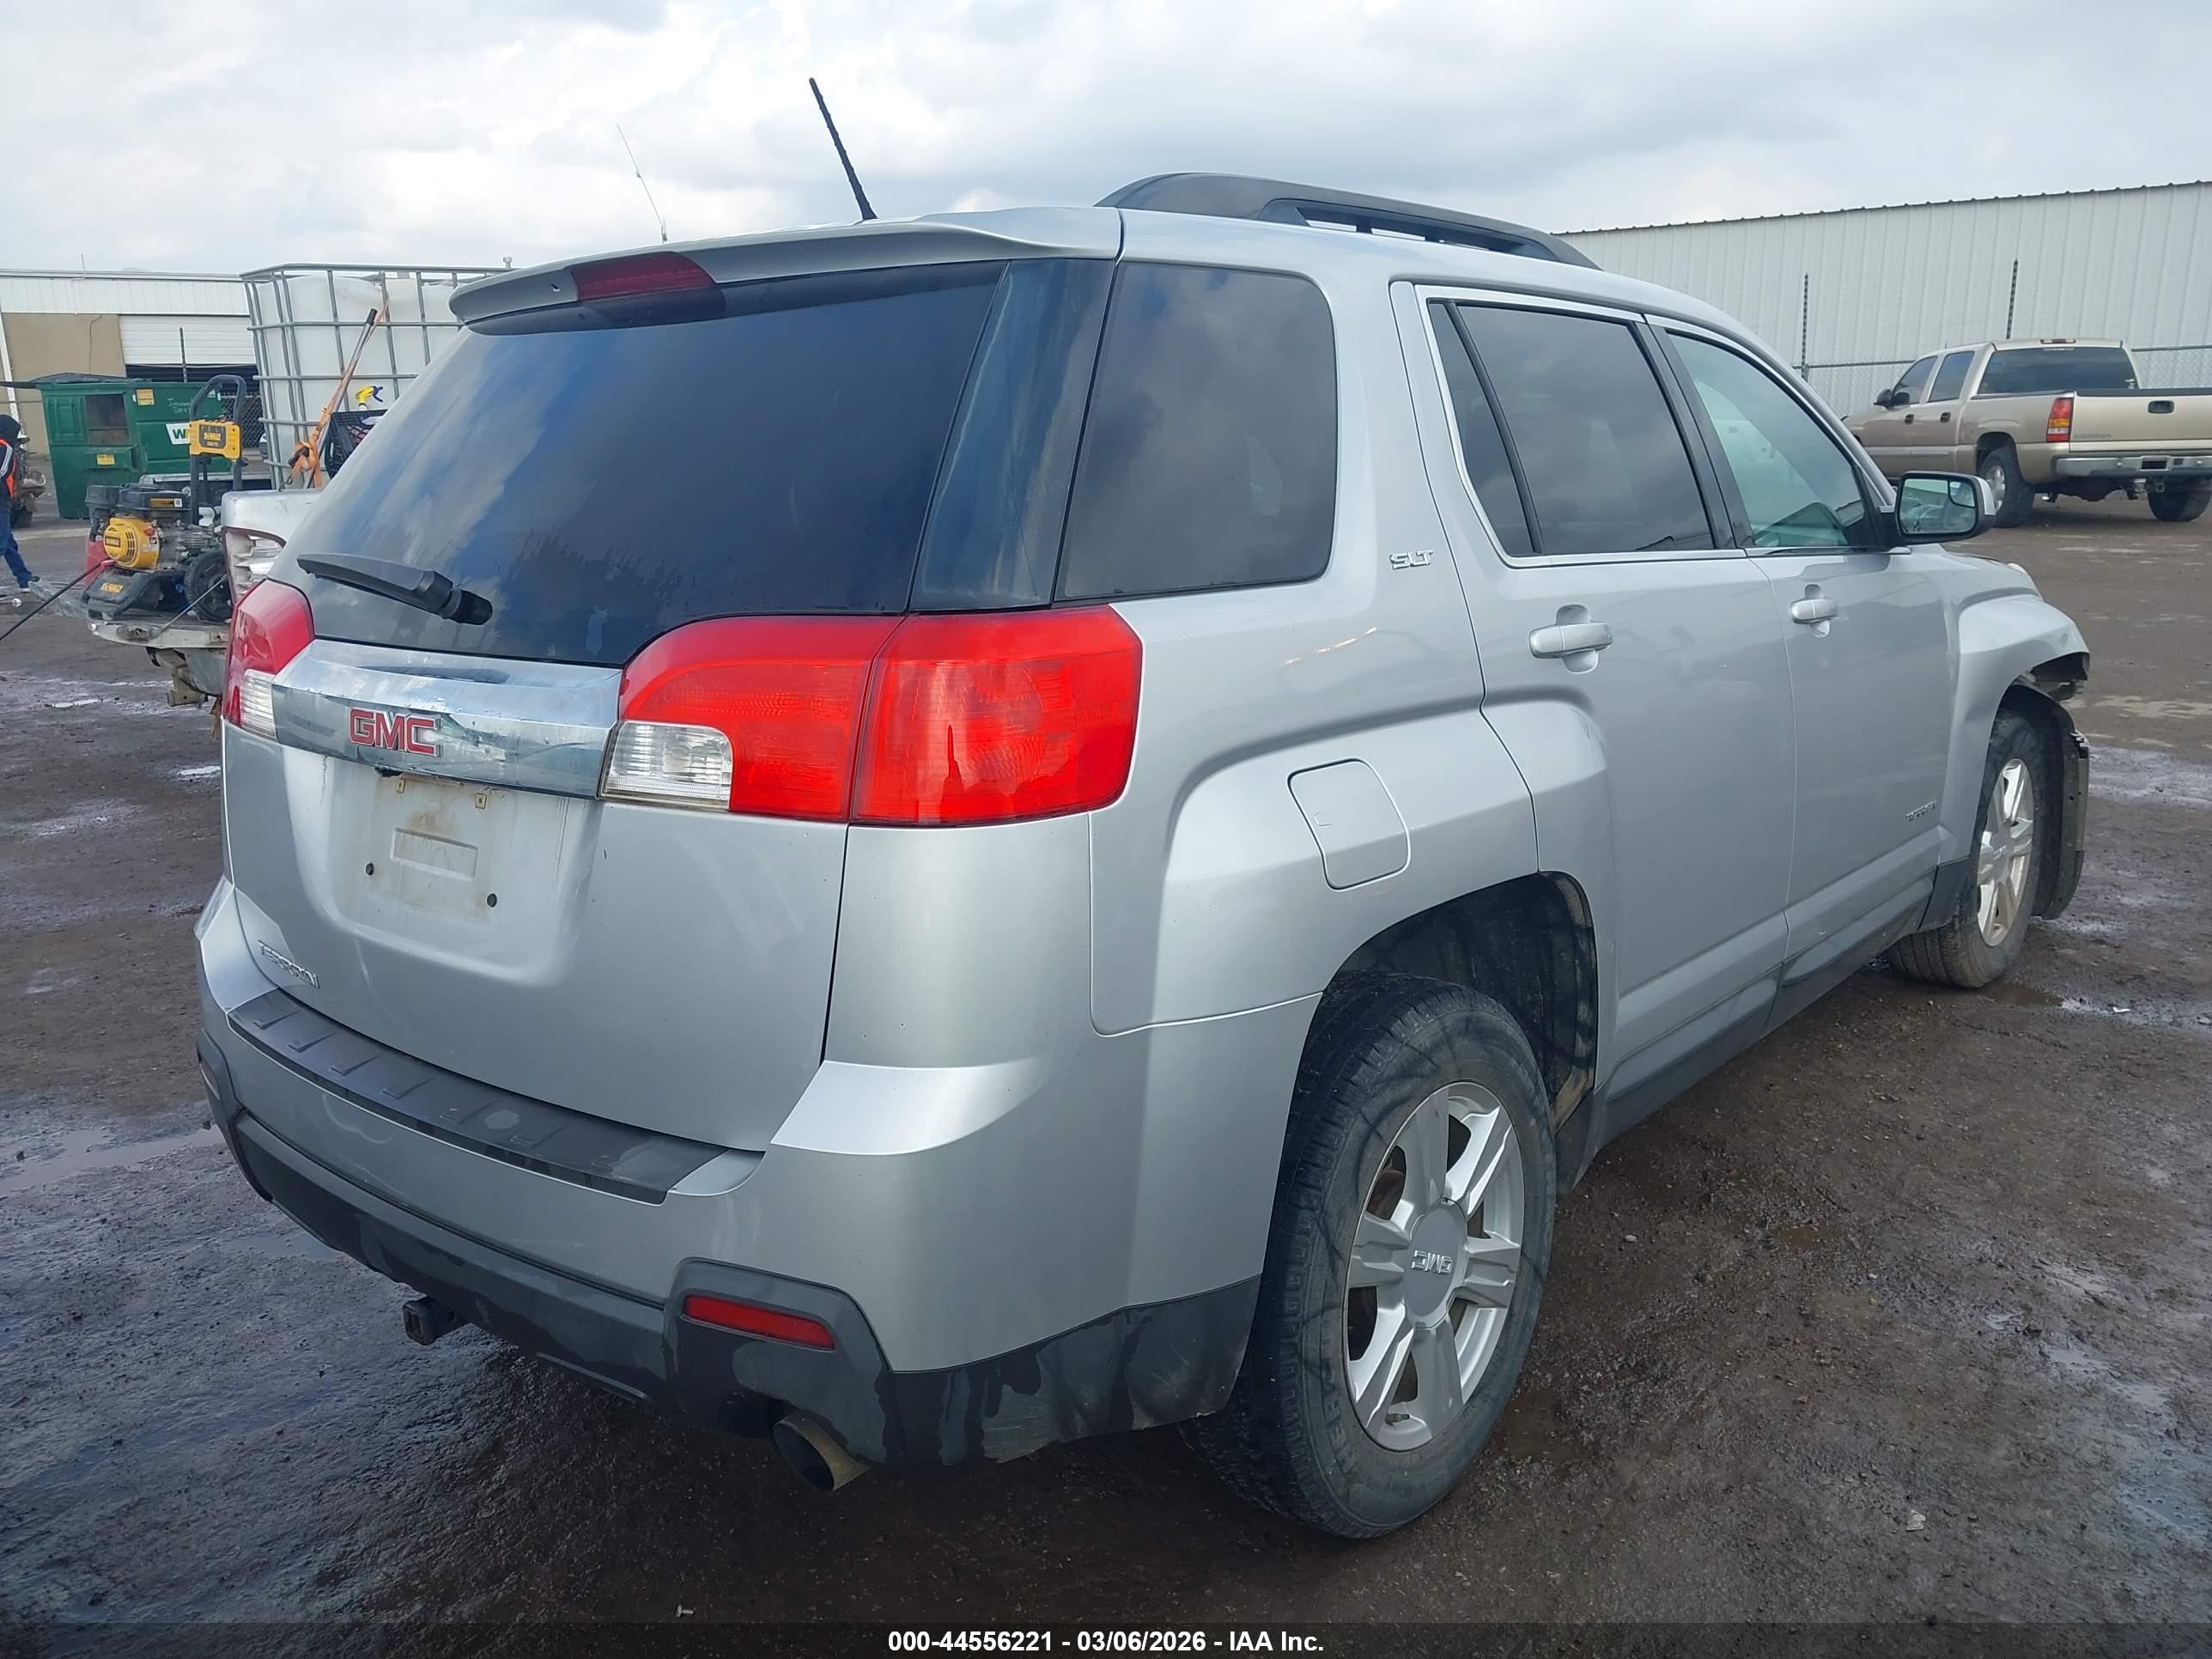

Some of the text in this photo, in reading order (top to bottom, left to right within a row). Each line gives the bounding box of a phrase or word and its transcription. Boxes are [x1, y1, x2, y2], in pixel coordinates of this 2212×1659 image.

[172, 428, 189, 440] W
[1389, 550, 1434, 569] SLT
[349, 707, 441, 758] GMC
[1411, 1249, 1453, 1274] GMC
